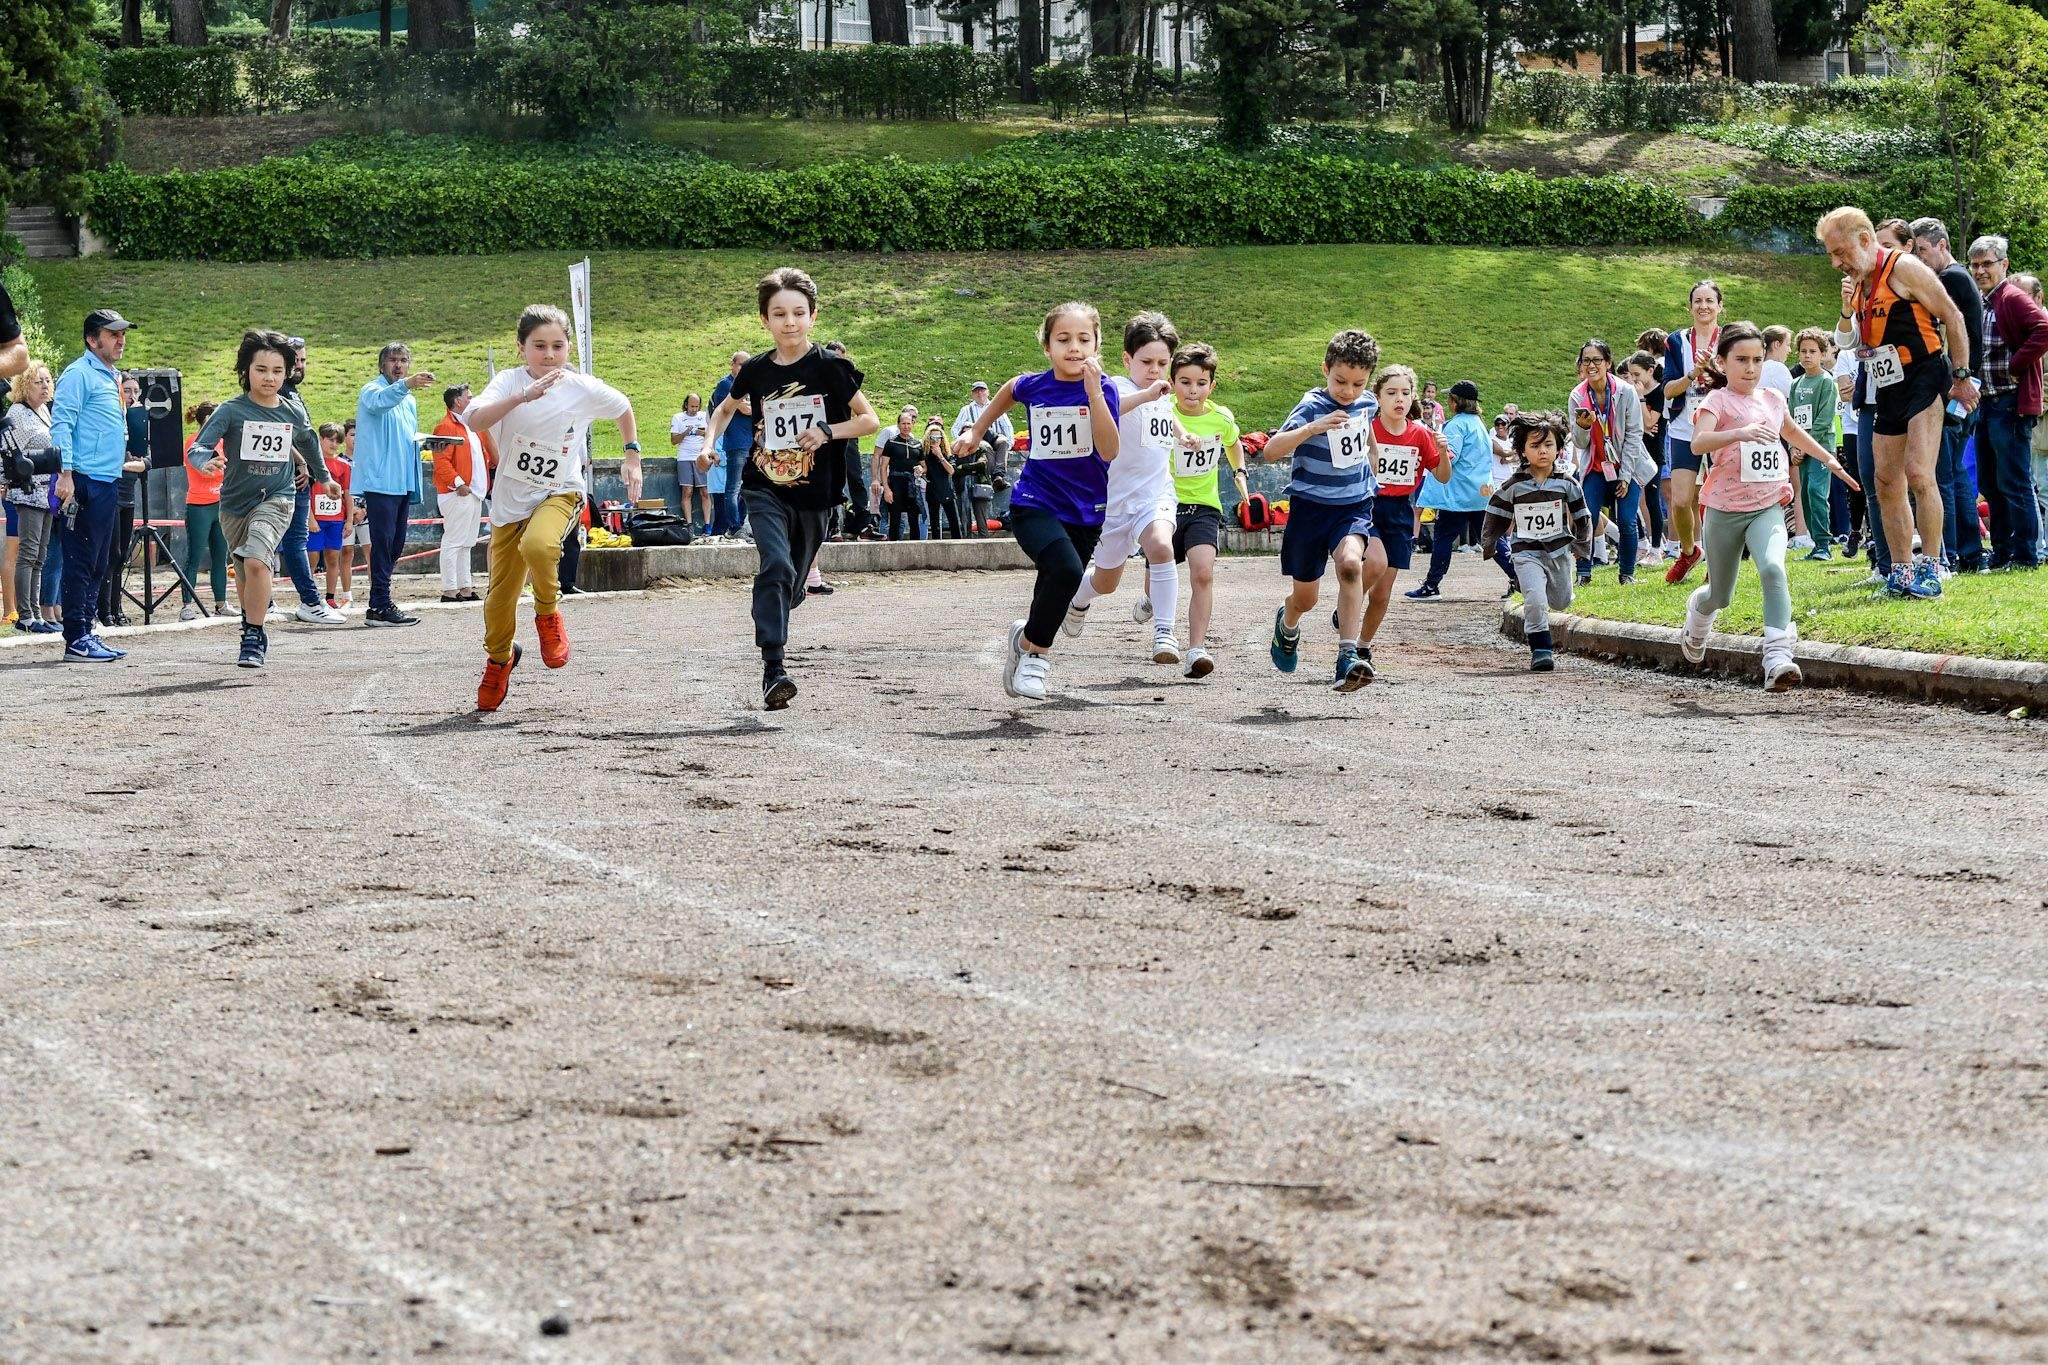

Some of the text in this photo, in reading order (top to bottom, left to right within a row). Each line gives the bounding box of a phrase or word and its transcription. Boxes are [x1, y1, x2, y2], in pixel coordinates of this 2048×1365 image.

[1872, 358, 1896, 379] 662
[775, 413, 814, 438] 817
[1040, 424, 1077, 447] 911
[252, 434, 283, 452] 793
[517, 452, 559, 479] 832
[1183, 448, 1215, 468] 787
[1378, 458, 1409, 476] 845
[1751, 450, 1779, 471] 856
[319, 501, 337, 511] 823
[1523, 513, 1556, 531] 794
